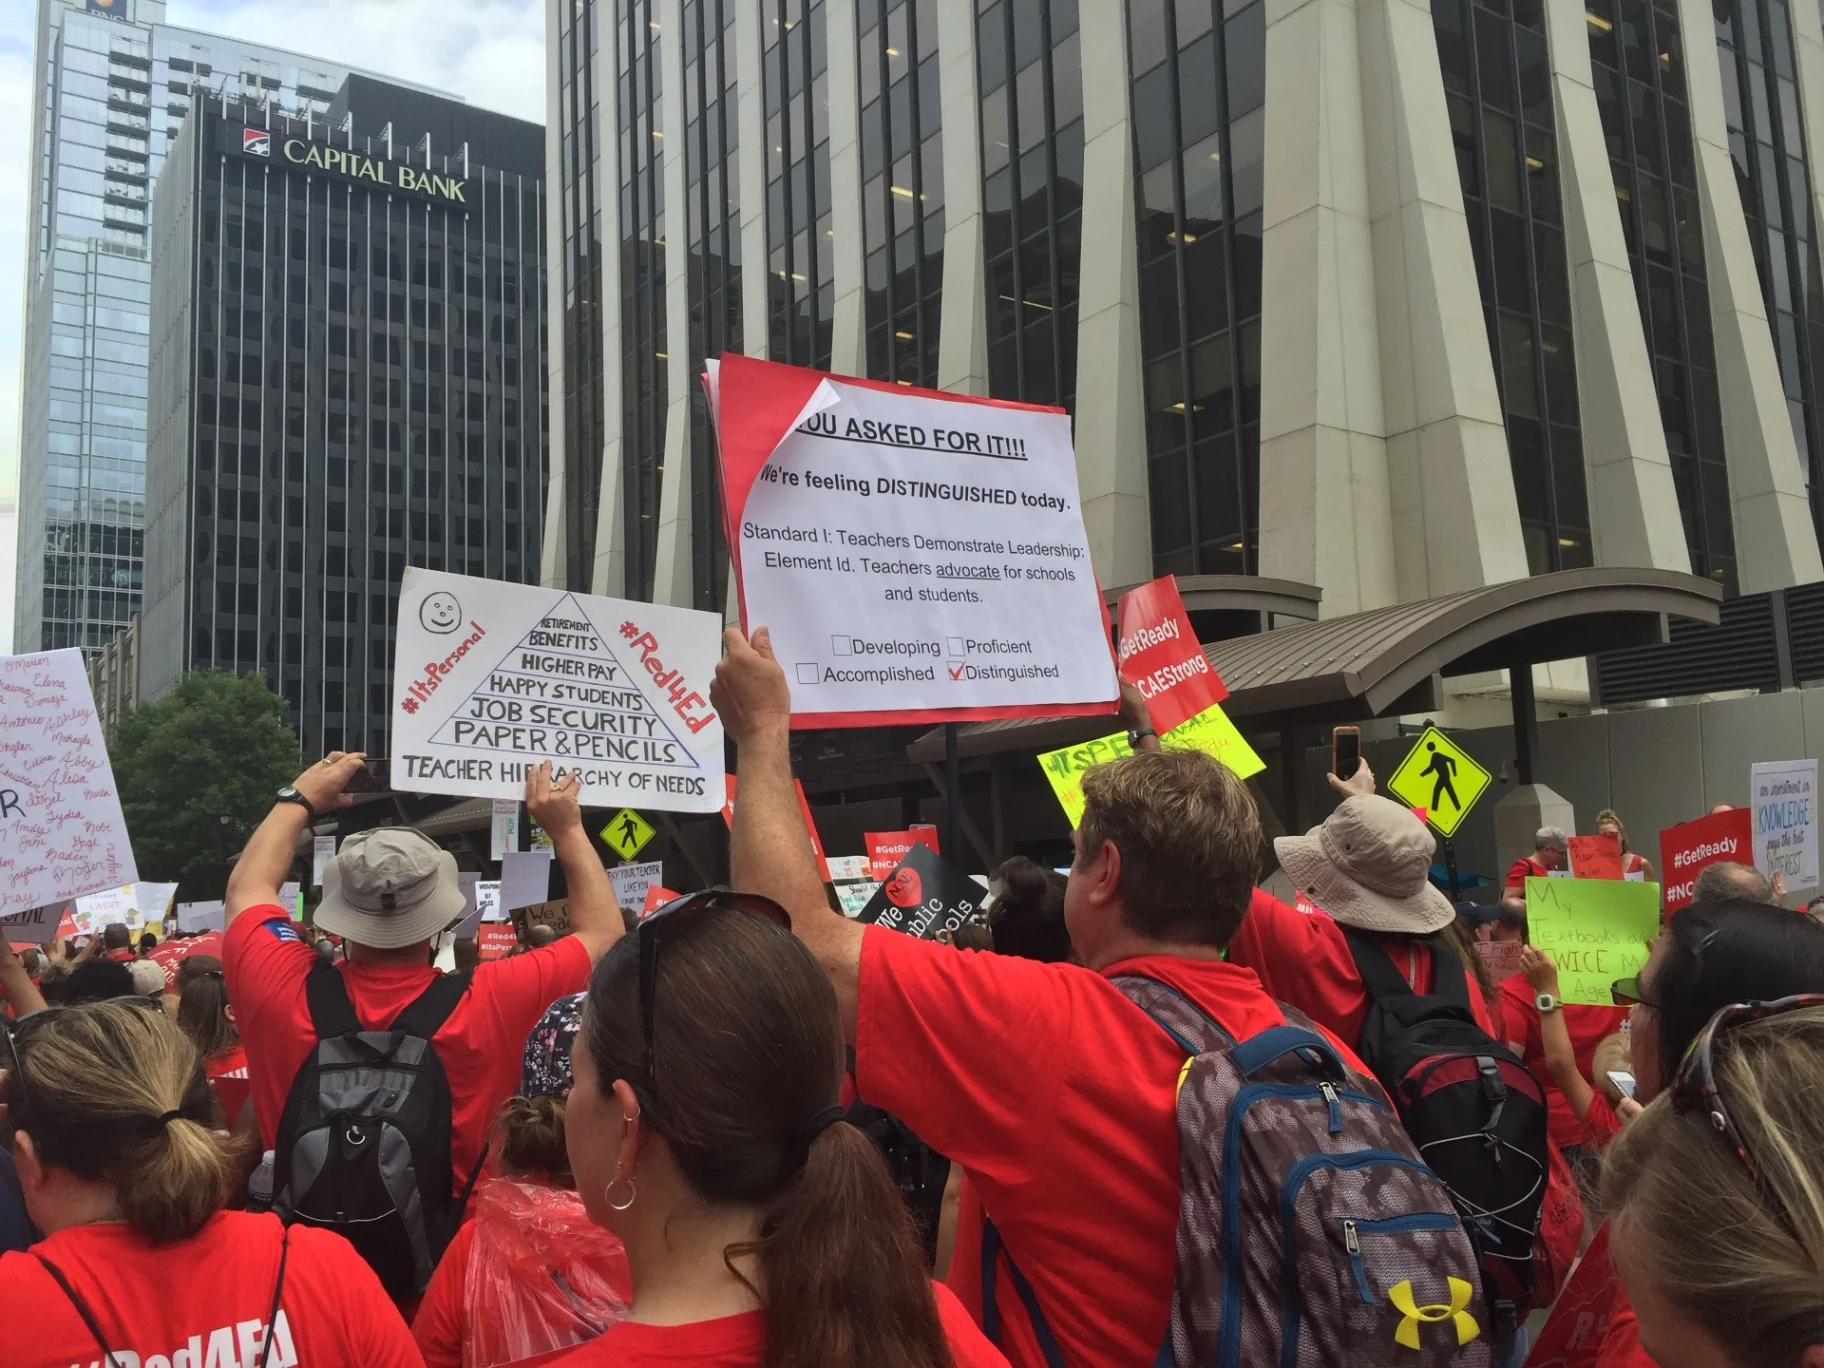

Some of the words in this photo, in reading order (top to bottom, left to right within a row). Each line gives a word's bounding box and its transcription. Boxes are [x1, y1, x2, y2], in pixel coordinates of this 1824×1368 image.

[284, 139, 392, 185] CAPITAL
[399, 165, 465, 202] BANK
[798, 412, 837, 436] OU
[845, 417, 926, 446] ASKED
[933, 428, 981, 453] FOR
[986, 434, 1027, 460] IT!!!
[760, 463, 799, 486] We're
[805, 471, 870, 497] feeling
[877, 477, 1017, 505] DISTINGUISHED
[1020, 491, 1071, 513] today.
[743, 522, 818, 543] Standard
[836, 529, 911, 549] Teachers
[913, 534, 1004, 554] Demonstrate
[1007, 540, 1085, 560] Leadership:
[764, 551, 833, 571] Element
[859, 557, 932, 576] Teachers
[936, 562, 1001, 580] advocate
[1003, 564, 1022, 579] for
[1026, 566, 1076, 581] schools
[884, 586, 913, 601] and
[919, 587, 983, 603] students.
[529, 630, 599, 651] BENEFITS
[541, 617, 592, 633] RETIREMENT
[1119, 617, 1180, 660] GetReady
[852, 638, 941, 658] Developing
[965, 639, 1033, 655] Proficient
[401, 620, 487, 715] #ItsPersonal
[521, 653, 586, 677] HIGHER
[588, 662, 617, 682] PAY
[618, 620, 717, 735] #Red4Ed
[823, 665, 935, 685] Accomplished
[964, 664, 1060, 682] Distinguished
[1132, 653, 1209, 701] CAEStrong
[490, 674, 549, 698] HAPPY
[552, 683, 643, 711] STUDENTS
[470, 696, 523, 722] JOB
[529, 704, 657, 737] SECURITY
[454, 720, 548, 752] PAPER
[554, 730, 572, 755] &
[573, 733, 676, 763] PENCILS
[402, 754, 493, 781] TEACHER
[627, 772, 652, 789] OF
[655, 775, 706, 796] NEEDS
[1758, 798, 1810, 836] KNOWLEDGE
[1673, 836, 1738, 869] #GetReady
[620, 867, 636, 880] YOUR
[636, 864, 661, 878] TEACHER
[623, 881, 637, 893] LIKE
[528, 905, 555, 921] We
[874, 906, 904, 931] We
[905, 897, 944, 939] ublic
[1527, 879, 1571, 921] My
[1528, 918, 1621, 945] Textbooks
[1574, 977, 1609, 1003] Age
